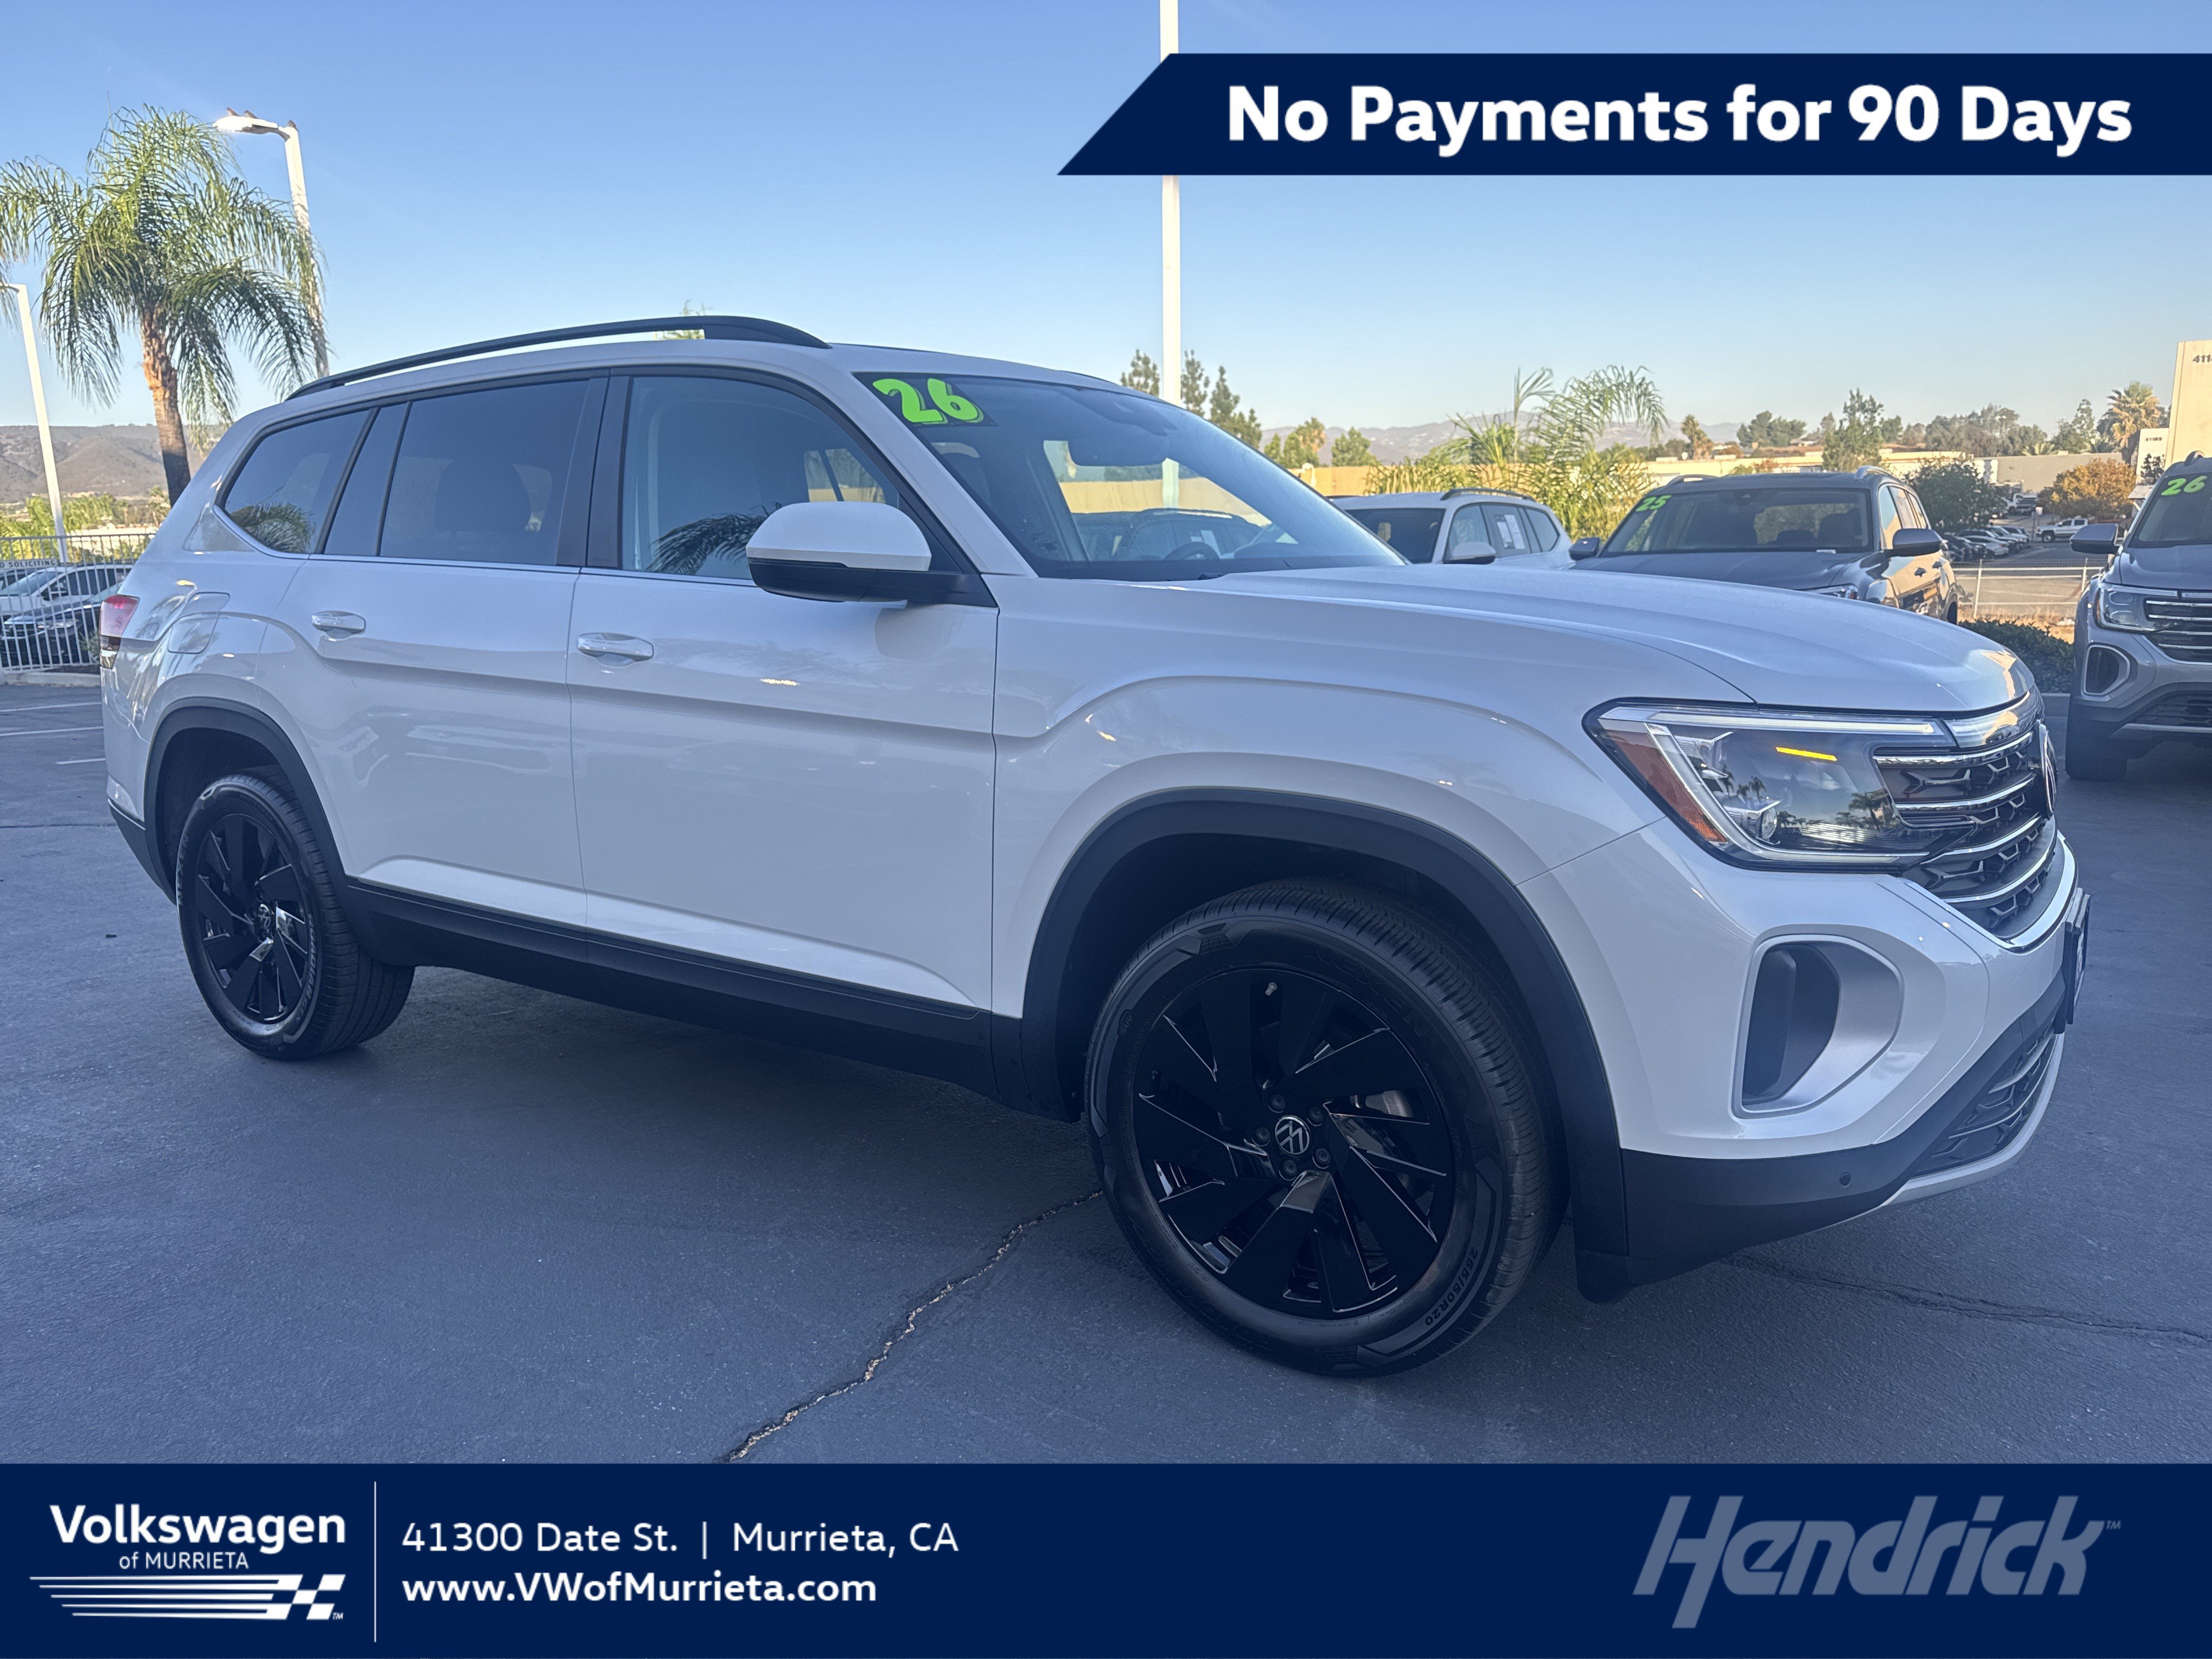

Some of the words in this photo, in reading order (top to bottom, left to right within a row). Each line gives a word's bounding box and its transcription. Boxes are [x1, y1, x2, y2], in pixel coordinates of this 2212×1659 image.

[2192, 354, 2212, 363] 411
[872, 378, 984, 425] 26
[2161, 475, 2208, 496] 26
[1635, 494, 1672, 512] 25
[1308, 940, 1431, 1039] NEXEN
[1424, 1246, 1478, 1326] 255/50R20
